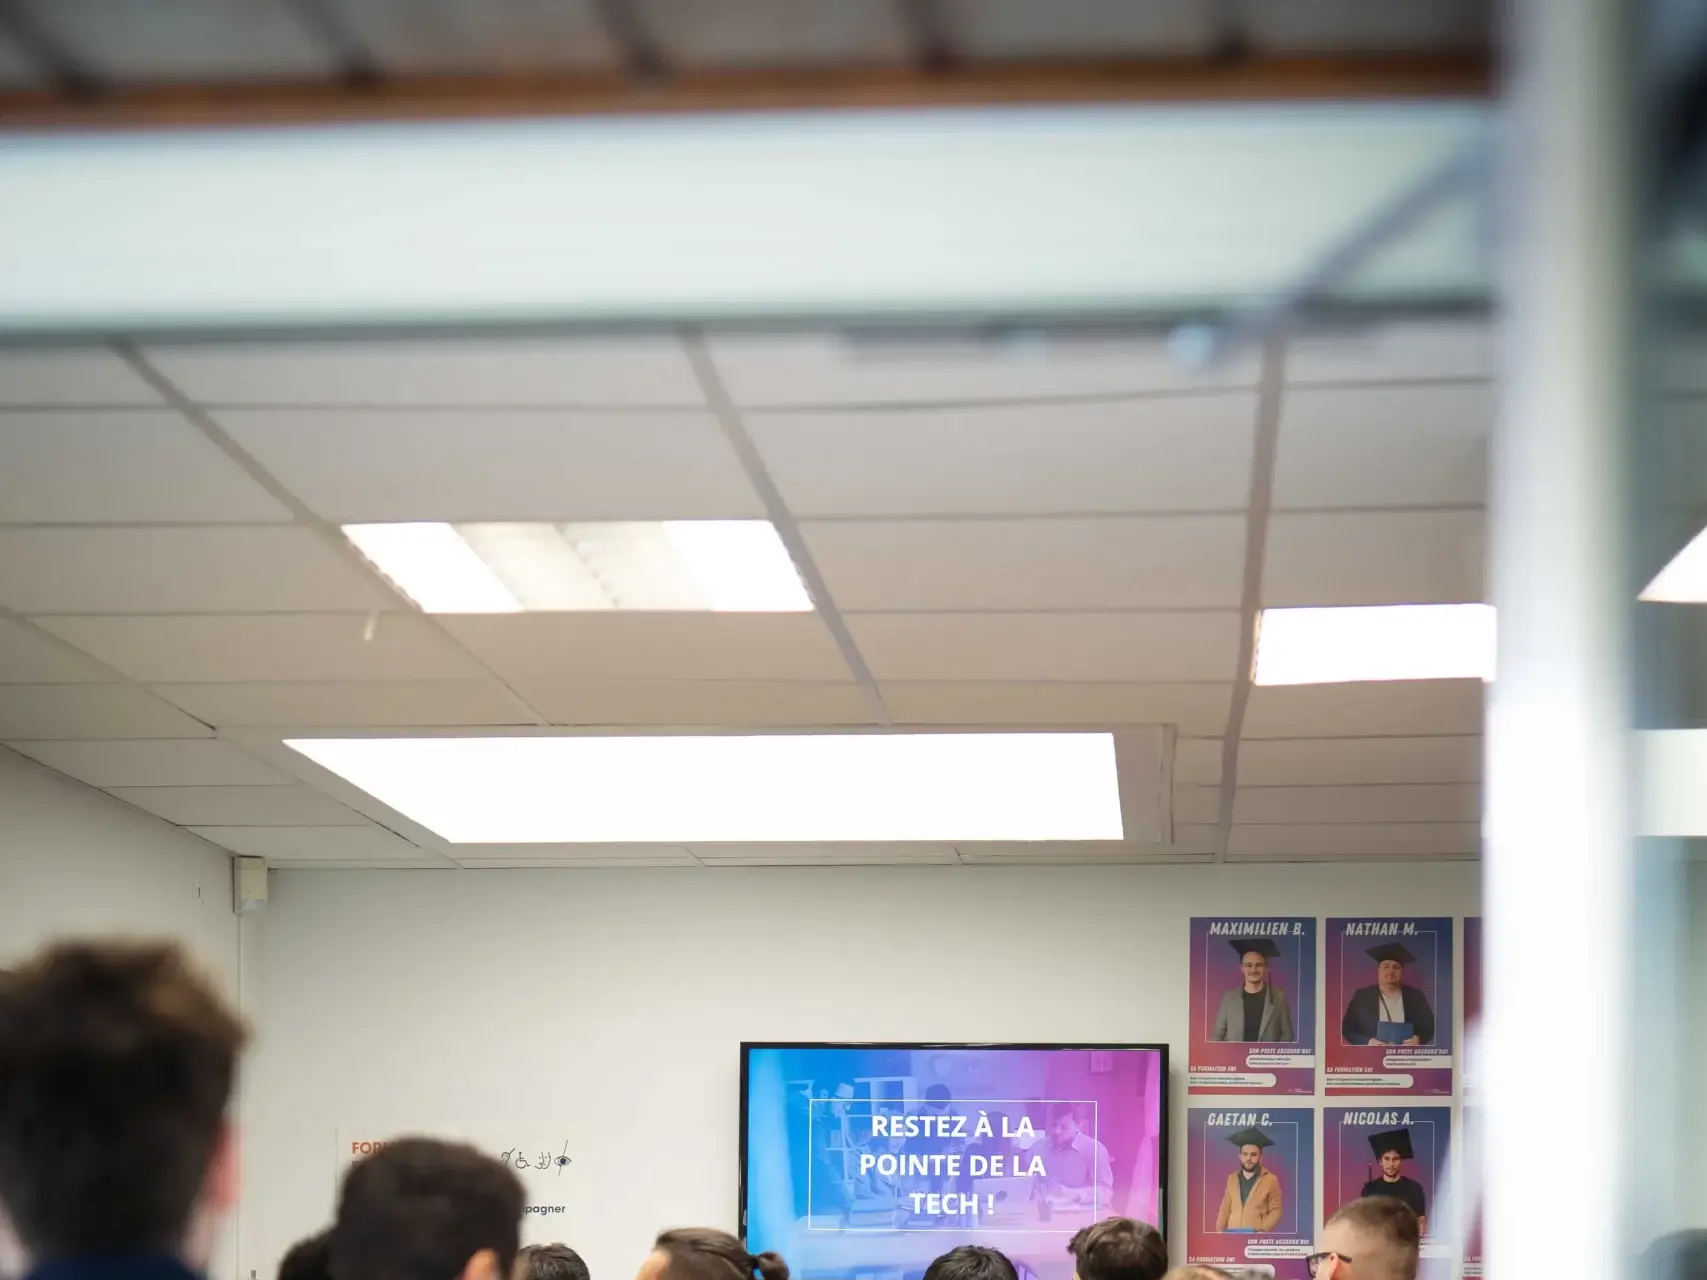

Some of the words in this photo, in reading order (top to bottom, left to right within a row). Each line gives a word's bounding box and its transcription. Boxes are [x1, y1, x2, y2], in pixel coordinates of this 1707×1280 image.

[1210, 922, 1287, 936] MAXIMILIEN
[1292, 922, 1305, 936] B.
[1345, 922, 1398, 936] NATHAN
[1403, 922, 1419, 936] M.
[871, 1116, 966, 1138] RESTEZ
[974, 1110, 994, 1138] À
[1002, 1116, 1035, 1138] LA
[1208, 1112, 1257, 1127] GAETAN
[1261, 1112, 1273, 1127] C.
[1343, 1112, 1397, 1125] NICOLAS
[1402, 1112, 1415, 1125] A.
[860, 1154, 961, 1176] POINTE
[970, 1155, 1003, 1176] DE
[1013, 1155, 1046, 1176] LA
[522, 1206, 566, 1216] pagner
[909, 1193, 979, 1215] TECH
